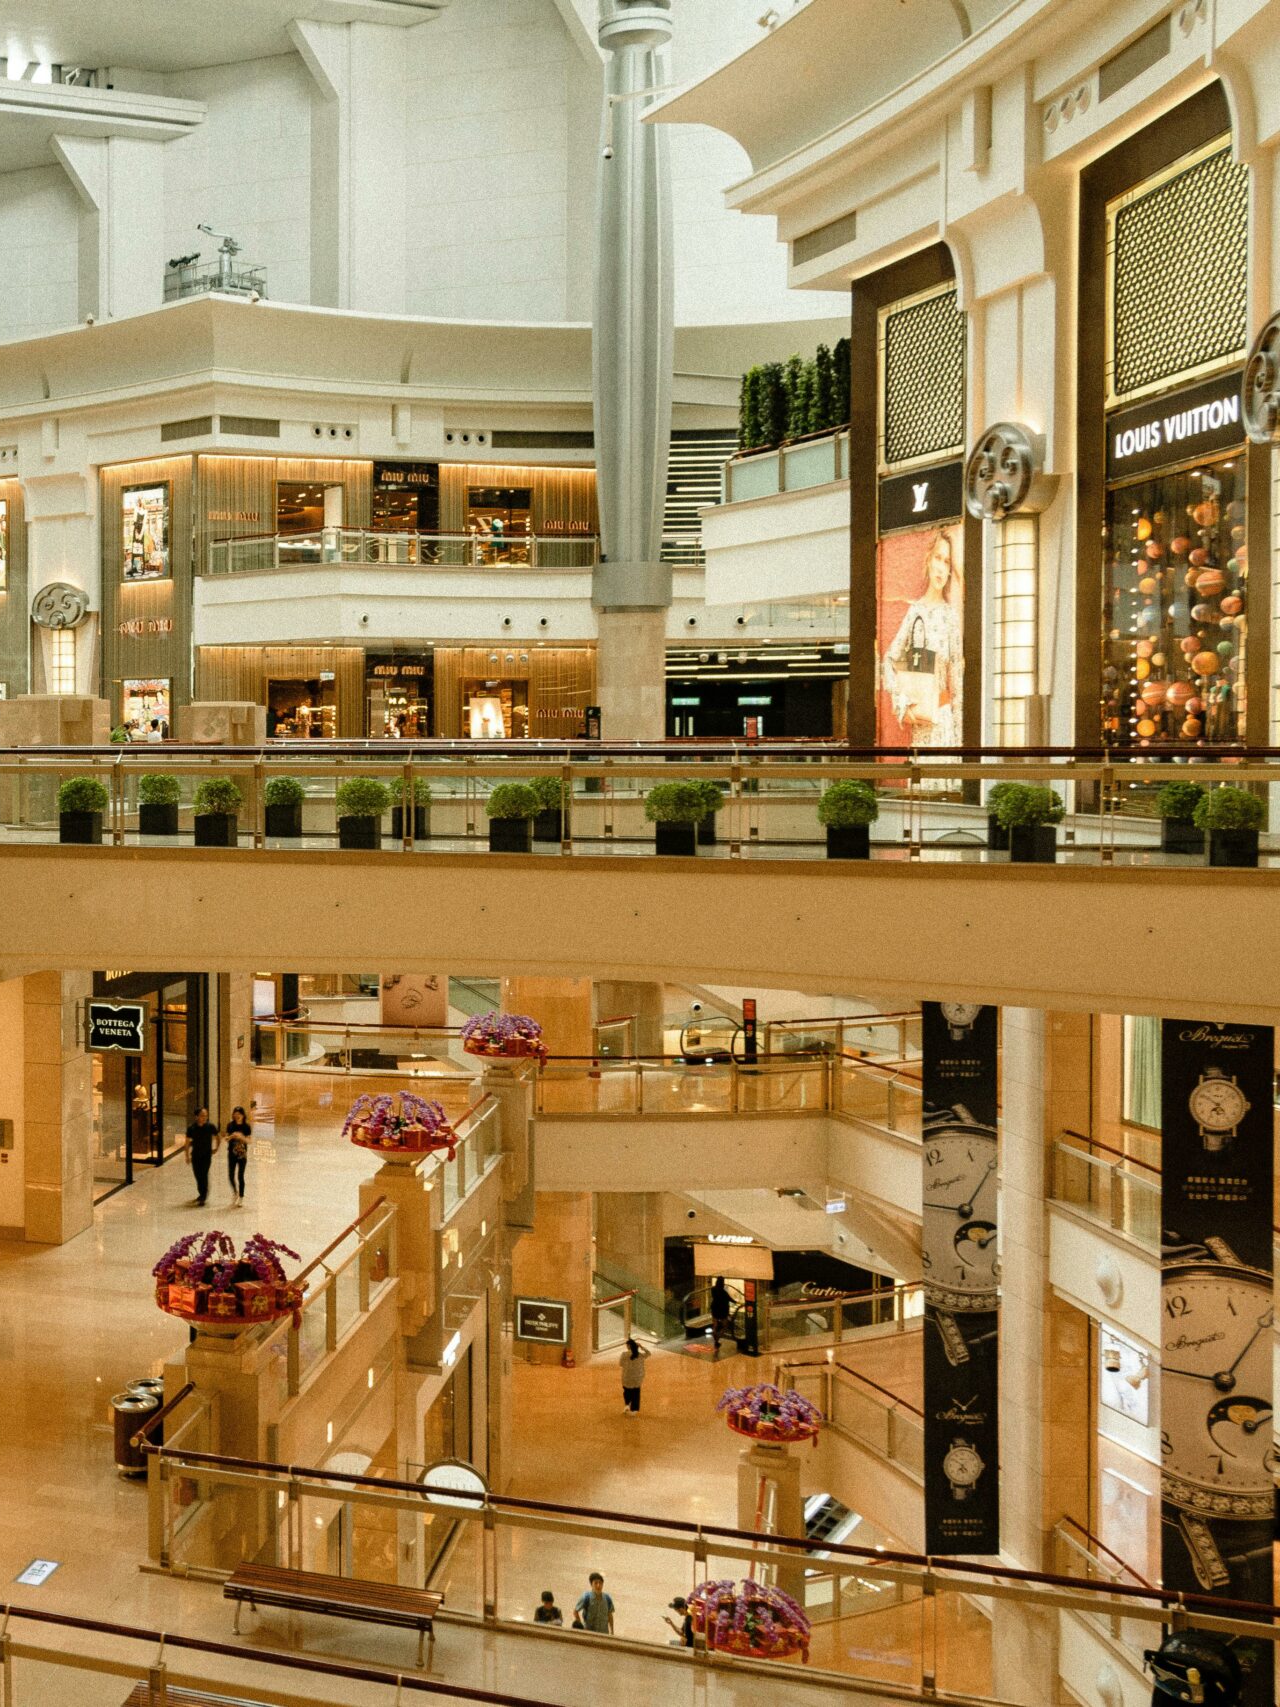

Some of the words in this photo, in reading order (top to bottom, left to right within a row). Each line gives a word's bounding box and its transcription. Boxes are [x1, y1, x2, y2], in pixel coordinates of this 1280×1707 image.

[1114, 420, 1160, 459] LOUIS
[1163, 394, 1239, 444] VUITTON
[96, 1018, 135, 1028] BOTTEGA
[99, 1027, 133, 1037] VENETA
[1165, 1295, 1193, 1319] 12
